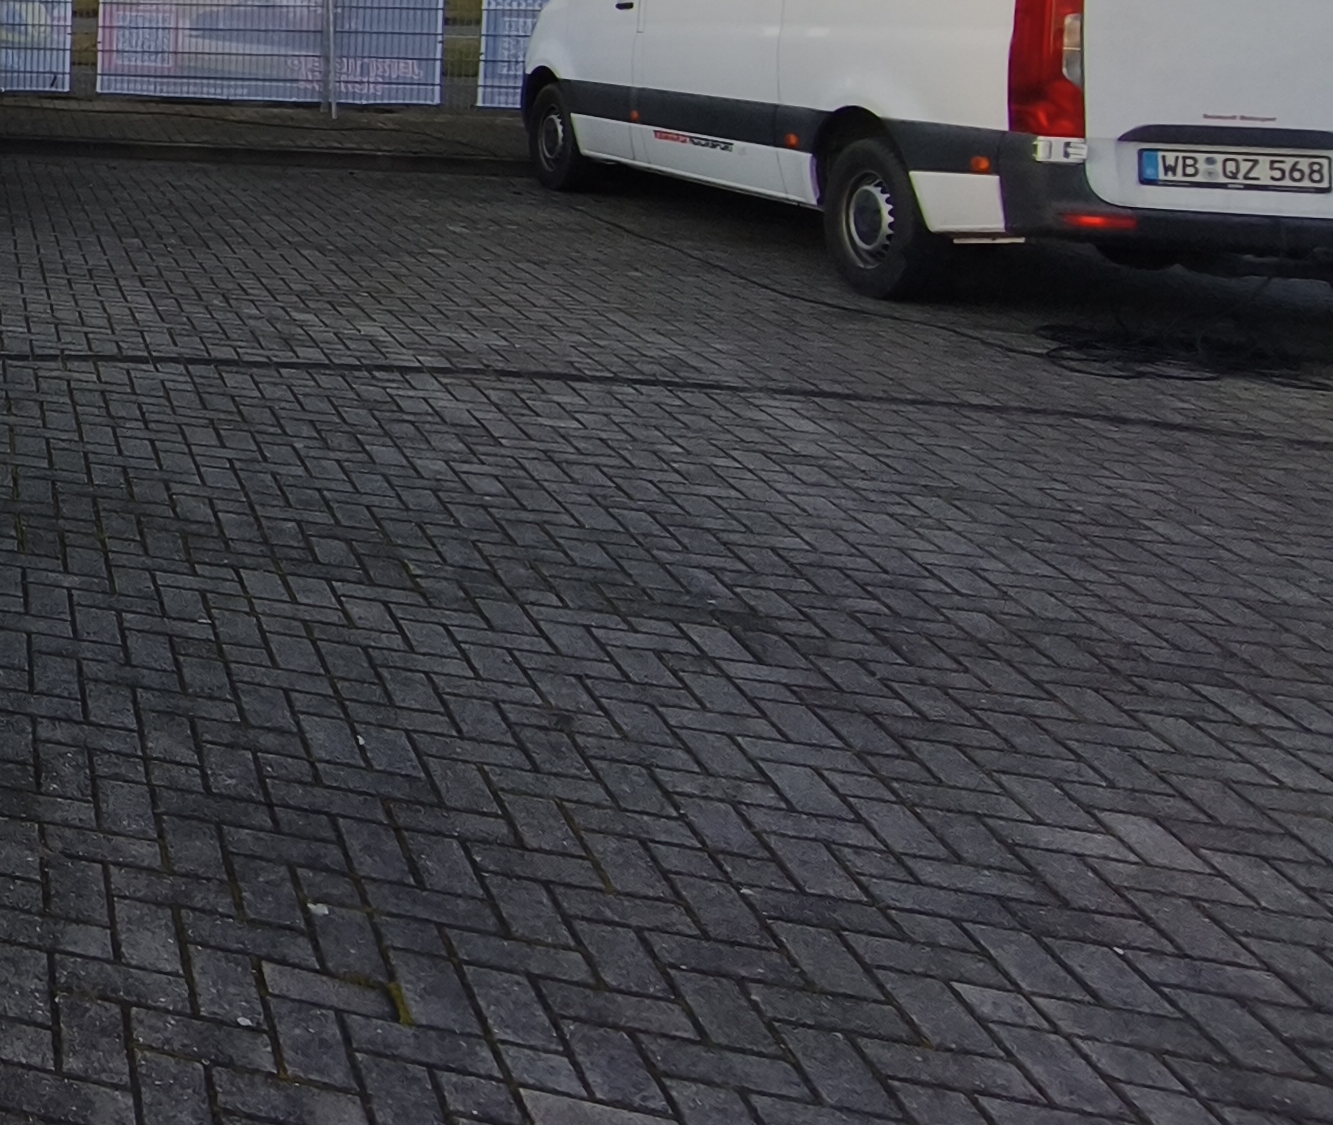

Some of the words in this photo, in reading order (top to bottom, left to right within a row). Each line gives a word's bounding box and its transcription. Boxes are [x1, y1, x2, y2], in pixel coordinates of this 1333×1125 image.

[1161, 154, 1200, 178] WB
[1222, 158, 1261, 182] QZ
[1269, 160, 1325, 184] 568
